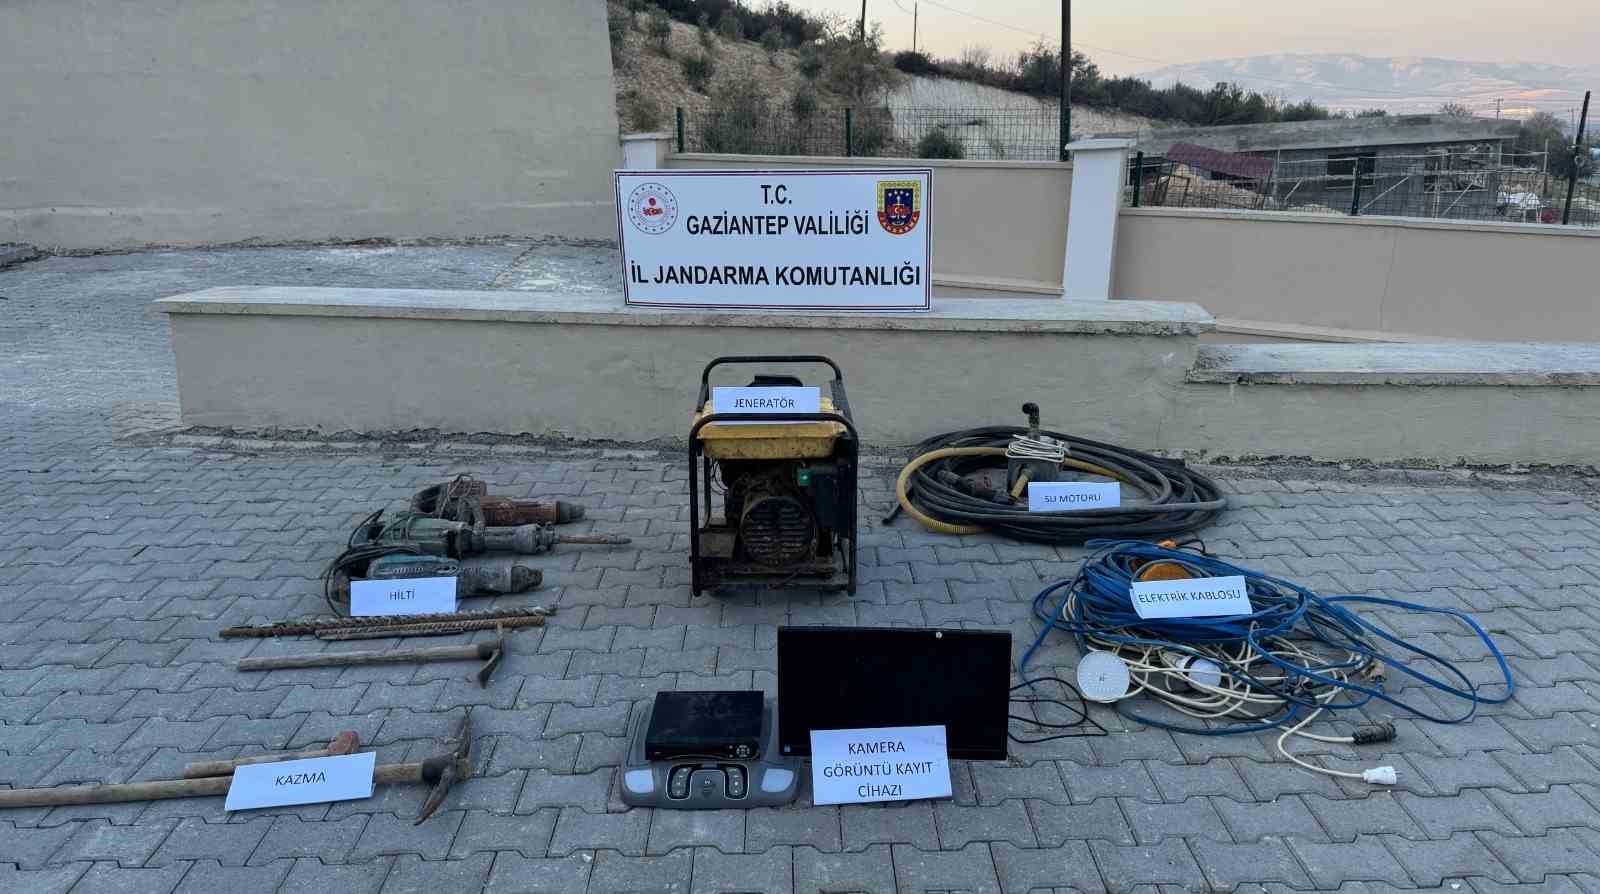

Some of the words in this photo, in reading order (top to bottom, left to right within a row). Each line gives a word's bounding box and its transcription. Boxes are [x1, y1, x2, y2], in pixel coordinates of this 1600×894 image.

[760, 184, 792, 205] T.C.
[686, 211, 789, 235] GAZİANTEP
[794, 209, 870, 235] VALİLİĞİ
[631, 260, 649, 284] İL
[654, 265, 769, 285] JANDARMA
[775, 261, 921, 286] KOMUTANLIĞI
[734, 395, 796, 409] JENERATÖR
[1058, 494, 1102, 503] MOTORU
[389, 588, 416, 601] HİLTİ
[1138, 591, 1187, 604] ELEKTRİK
[1191, 589, 1241, 601] KABLOSU
[848, 741, 906, 755] KAMERA
[823, 762, 891, 778] GÖRÜNTÜ
[896, 761, 933, 775] KAYIT
[275, 770, 327, 786] KAZMA
[858, 782, 902, 798] CİHAZI
